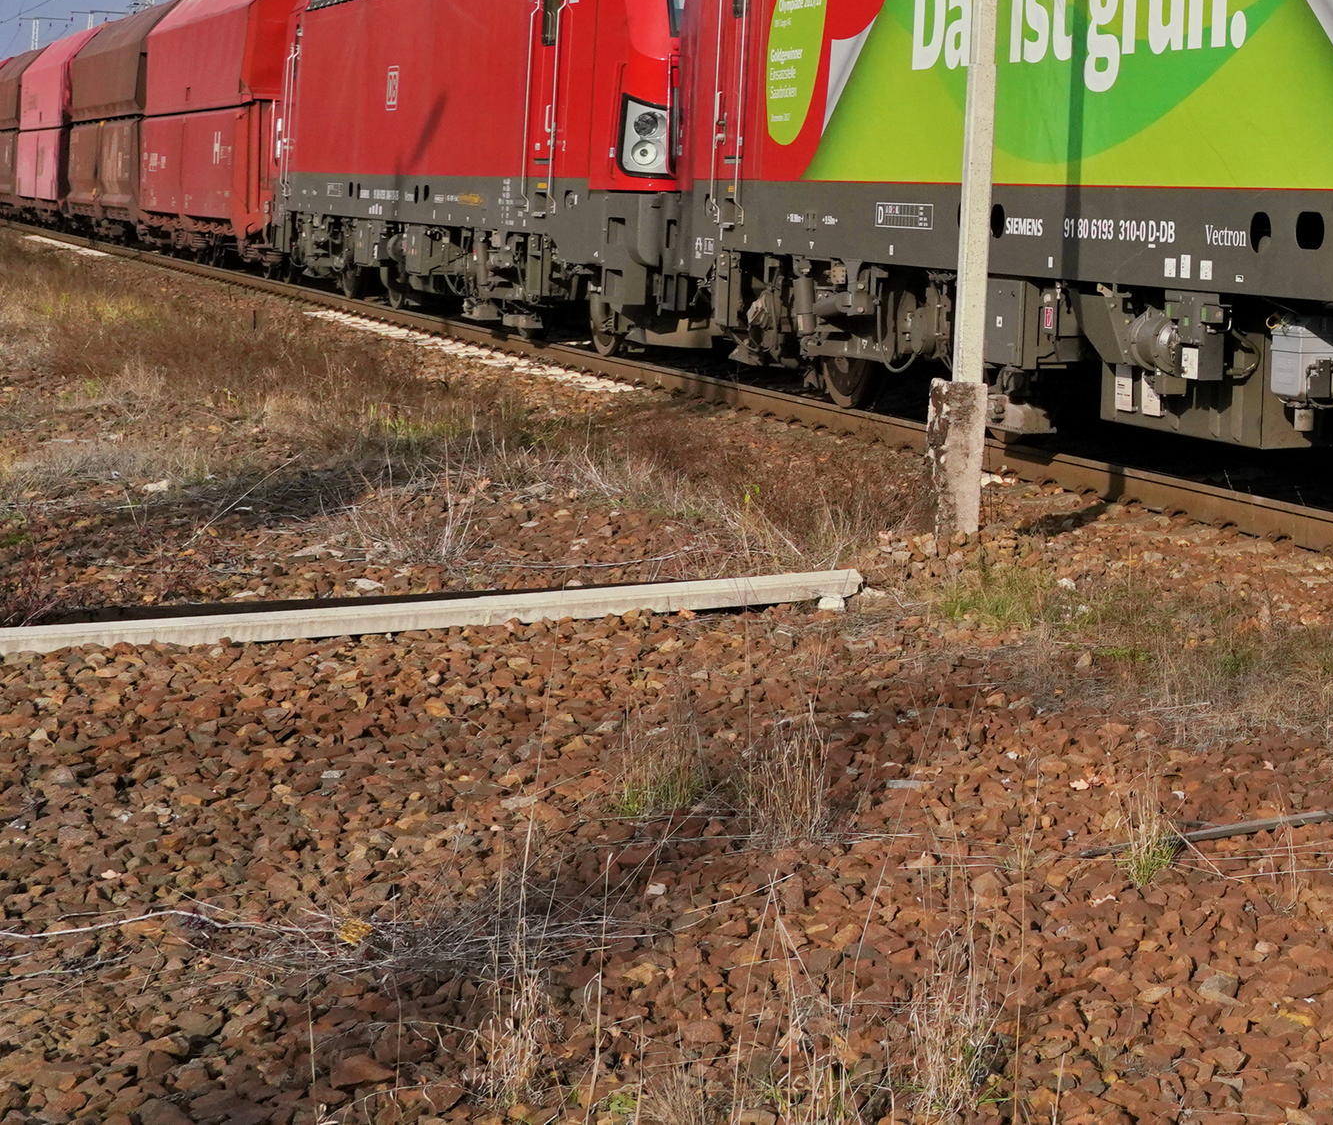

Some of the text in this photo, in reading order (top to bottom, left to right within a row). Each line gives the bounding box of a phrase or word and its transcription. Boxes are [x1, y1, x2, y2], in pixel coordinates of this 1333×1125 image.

[1005, 217, 1247, 247] SIEMENS 91 80 6193 310-0 D-DB Vectron
